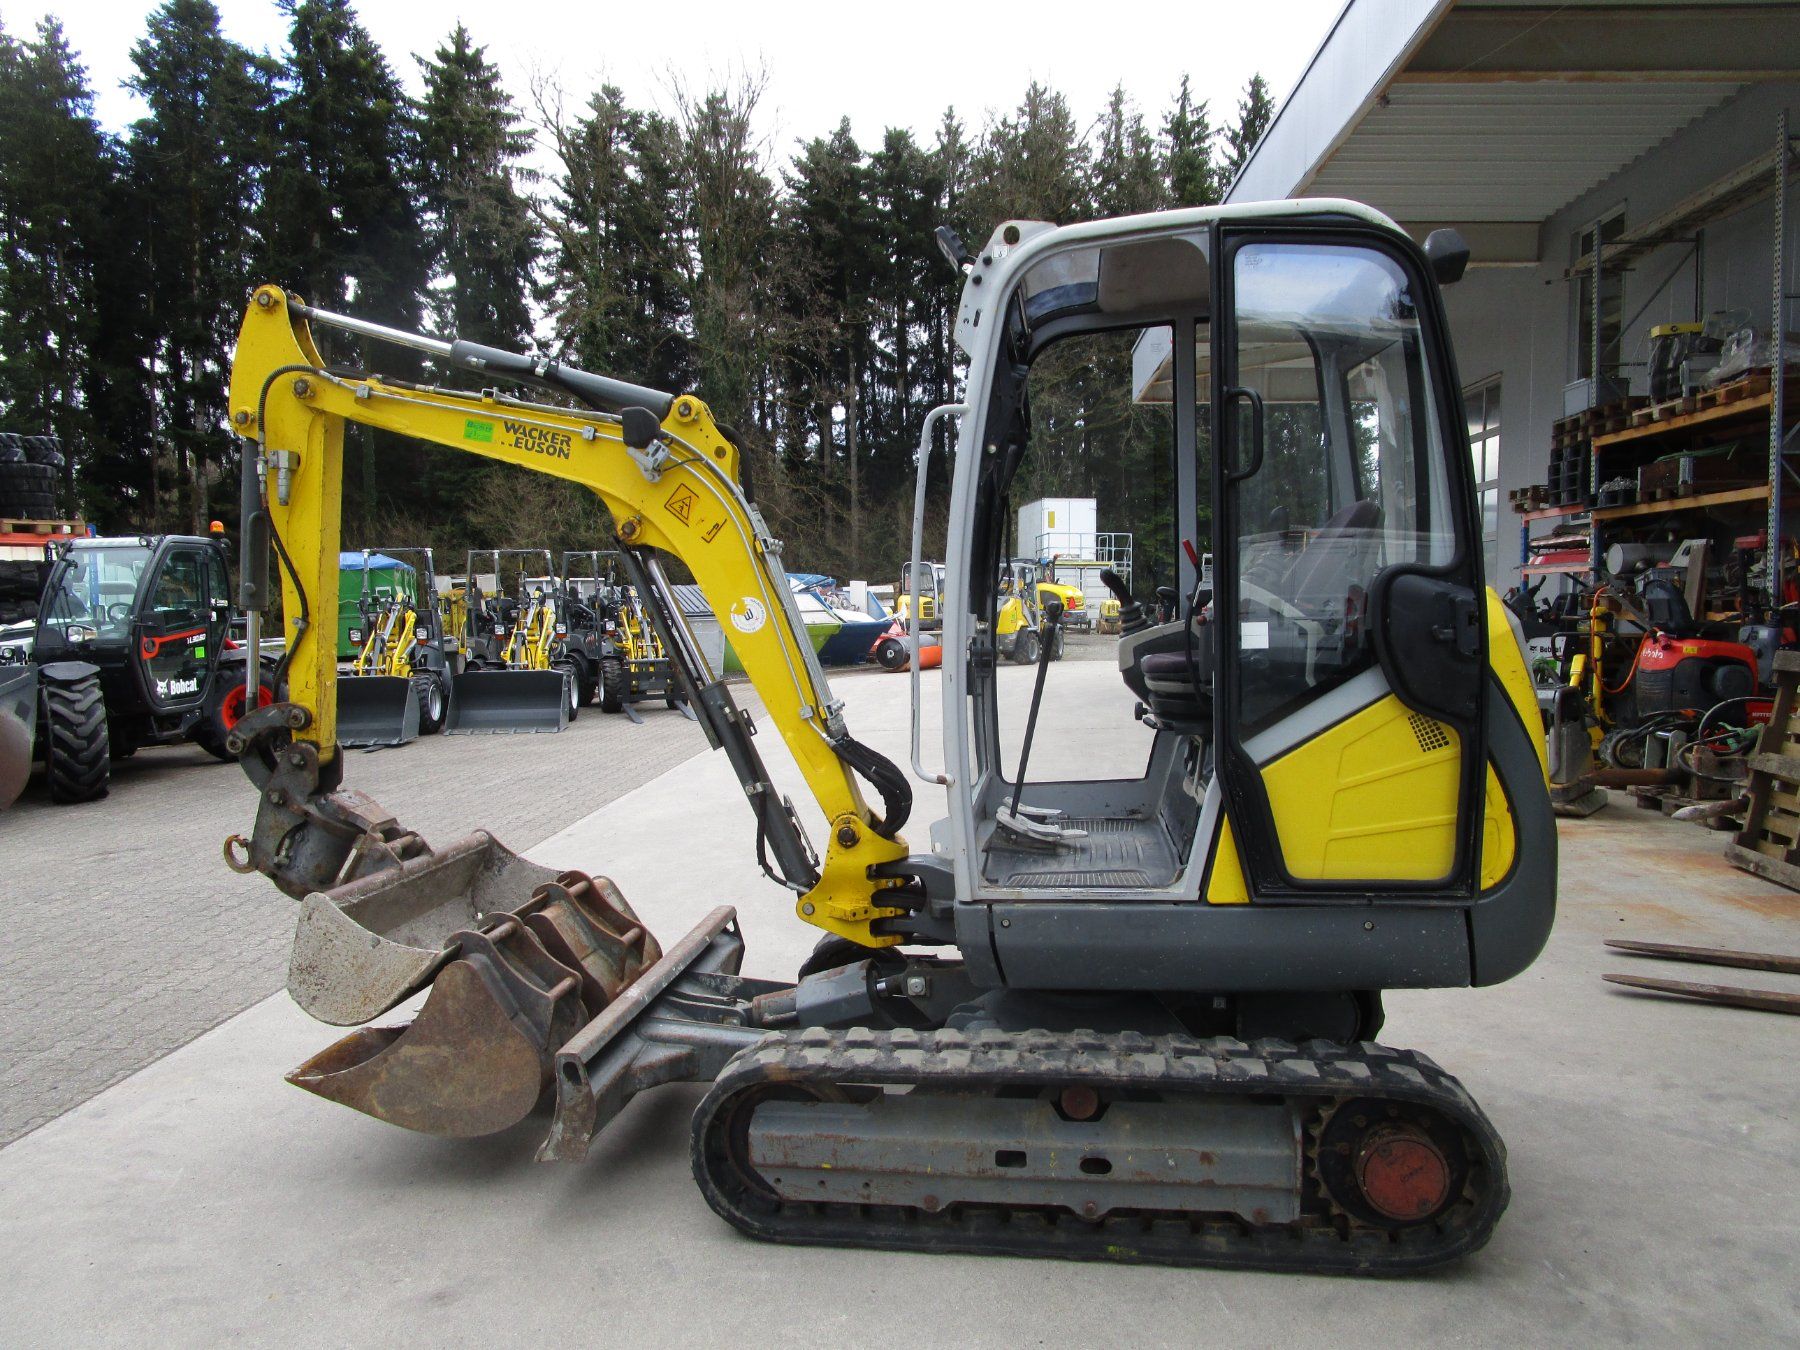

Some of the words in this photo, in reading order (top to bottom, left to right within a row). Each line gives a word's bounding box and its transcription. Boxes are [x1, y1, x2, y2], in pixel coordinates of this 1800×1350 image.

[503, 420, 571, 448] WACKER
[500, 436, 570, 460] EUSON
[1539, 645, 1562, 653] Bobat
[170, 677, 198, 696] Bobcat
